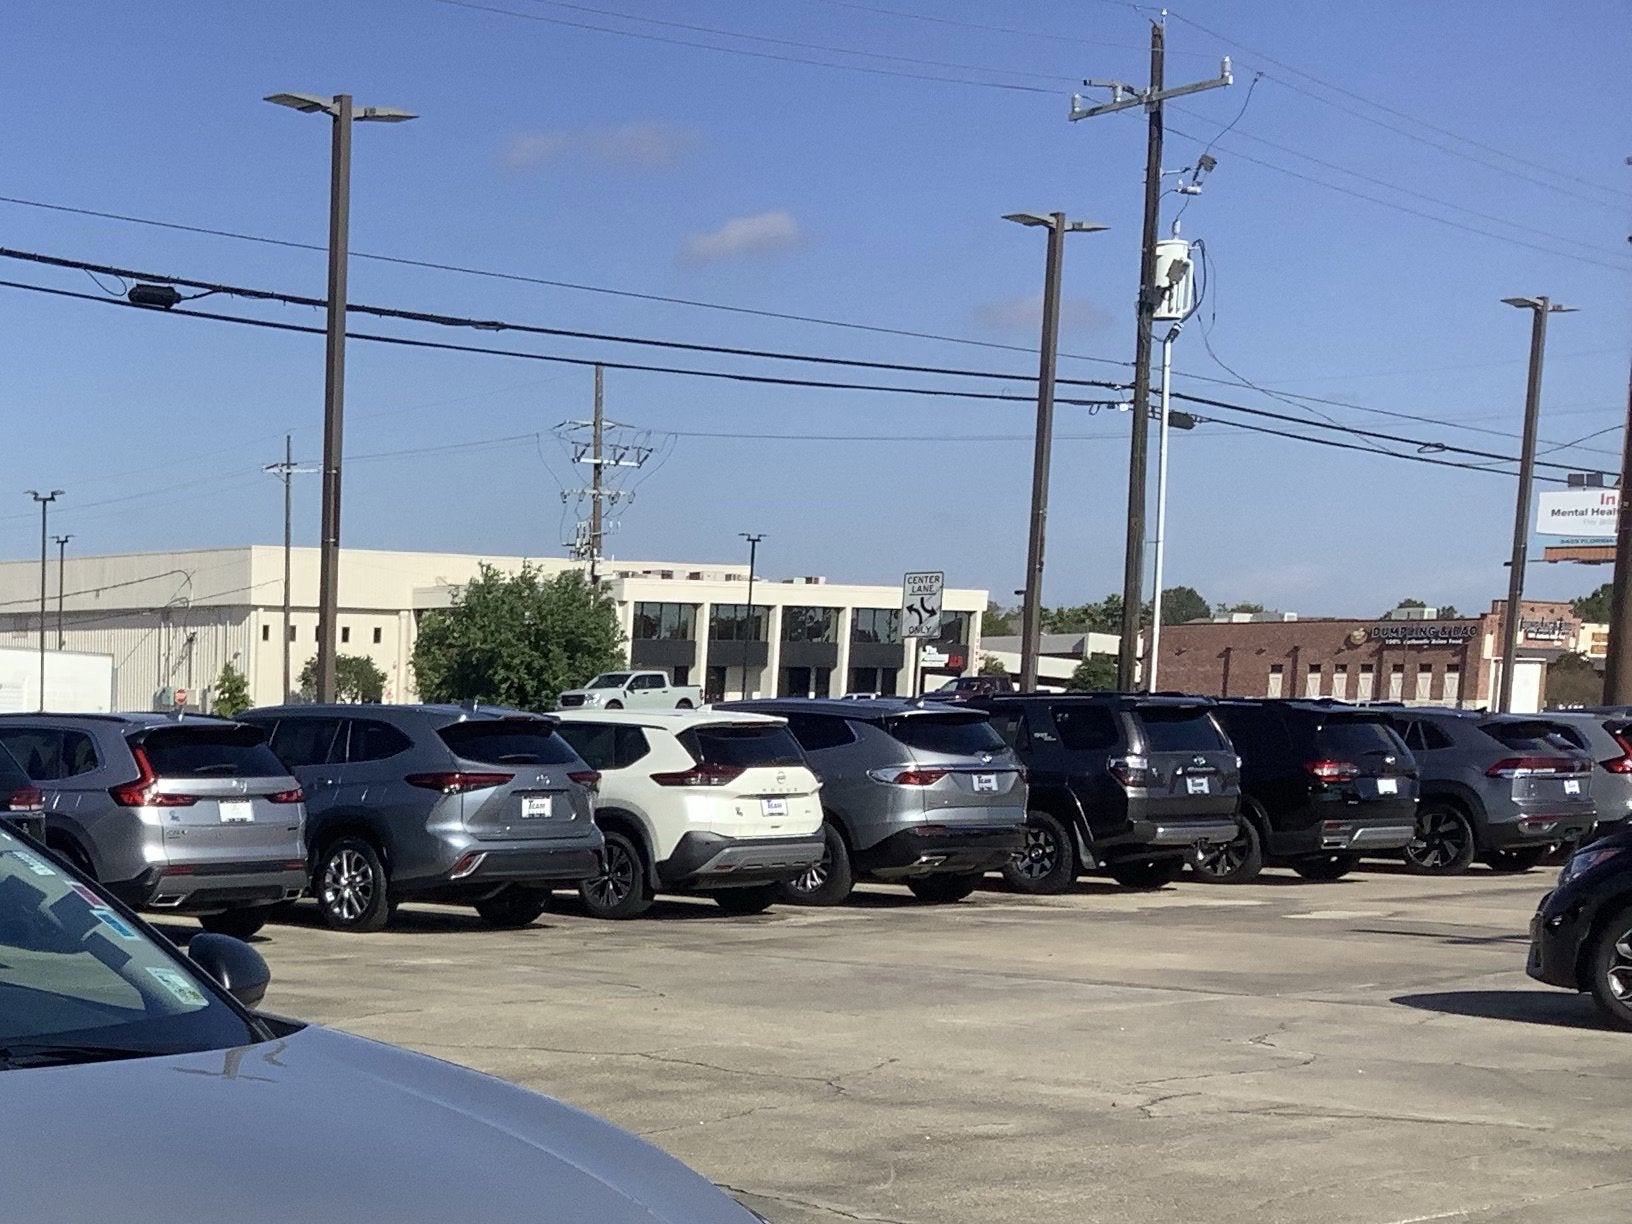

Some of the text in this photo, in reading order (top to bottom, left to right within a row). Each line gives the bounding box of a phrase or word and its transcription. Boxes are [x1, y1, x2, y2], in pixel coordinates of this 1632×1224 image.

[1551, 507, 1618, 517] Mental Heal
[907, 575, 940, 584] CENTER
[911, 585, 935, 593] LANE
[908, 625, 932, 634] ONLY
[1371, 626, 1436, 638] DUMPLING
